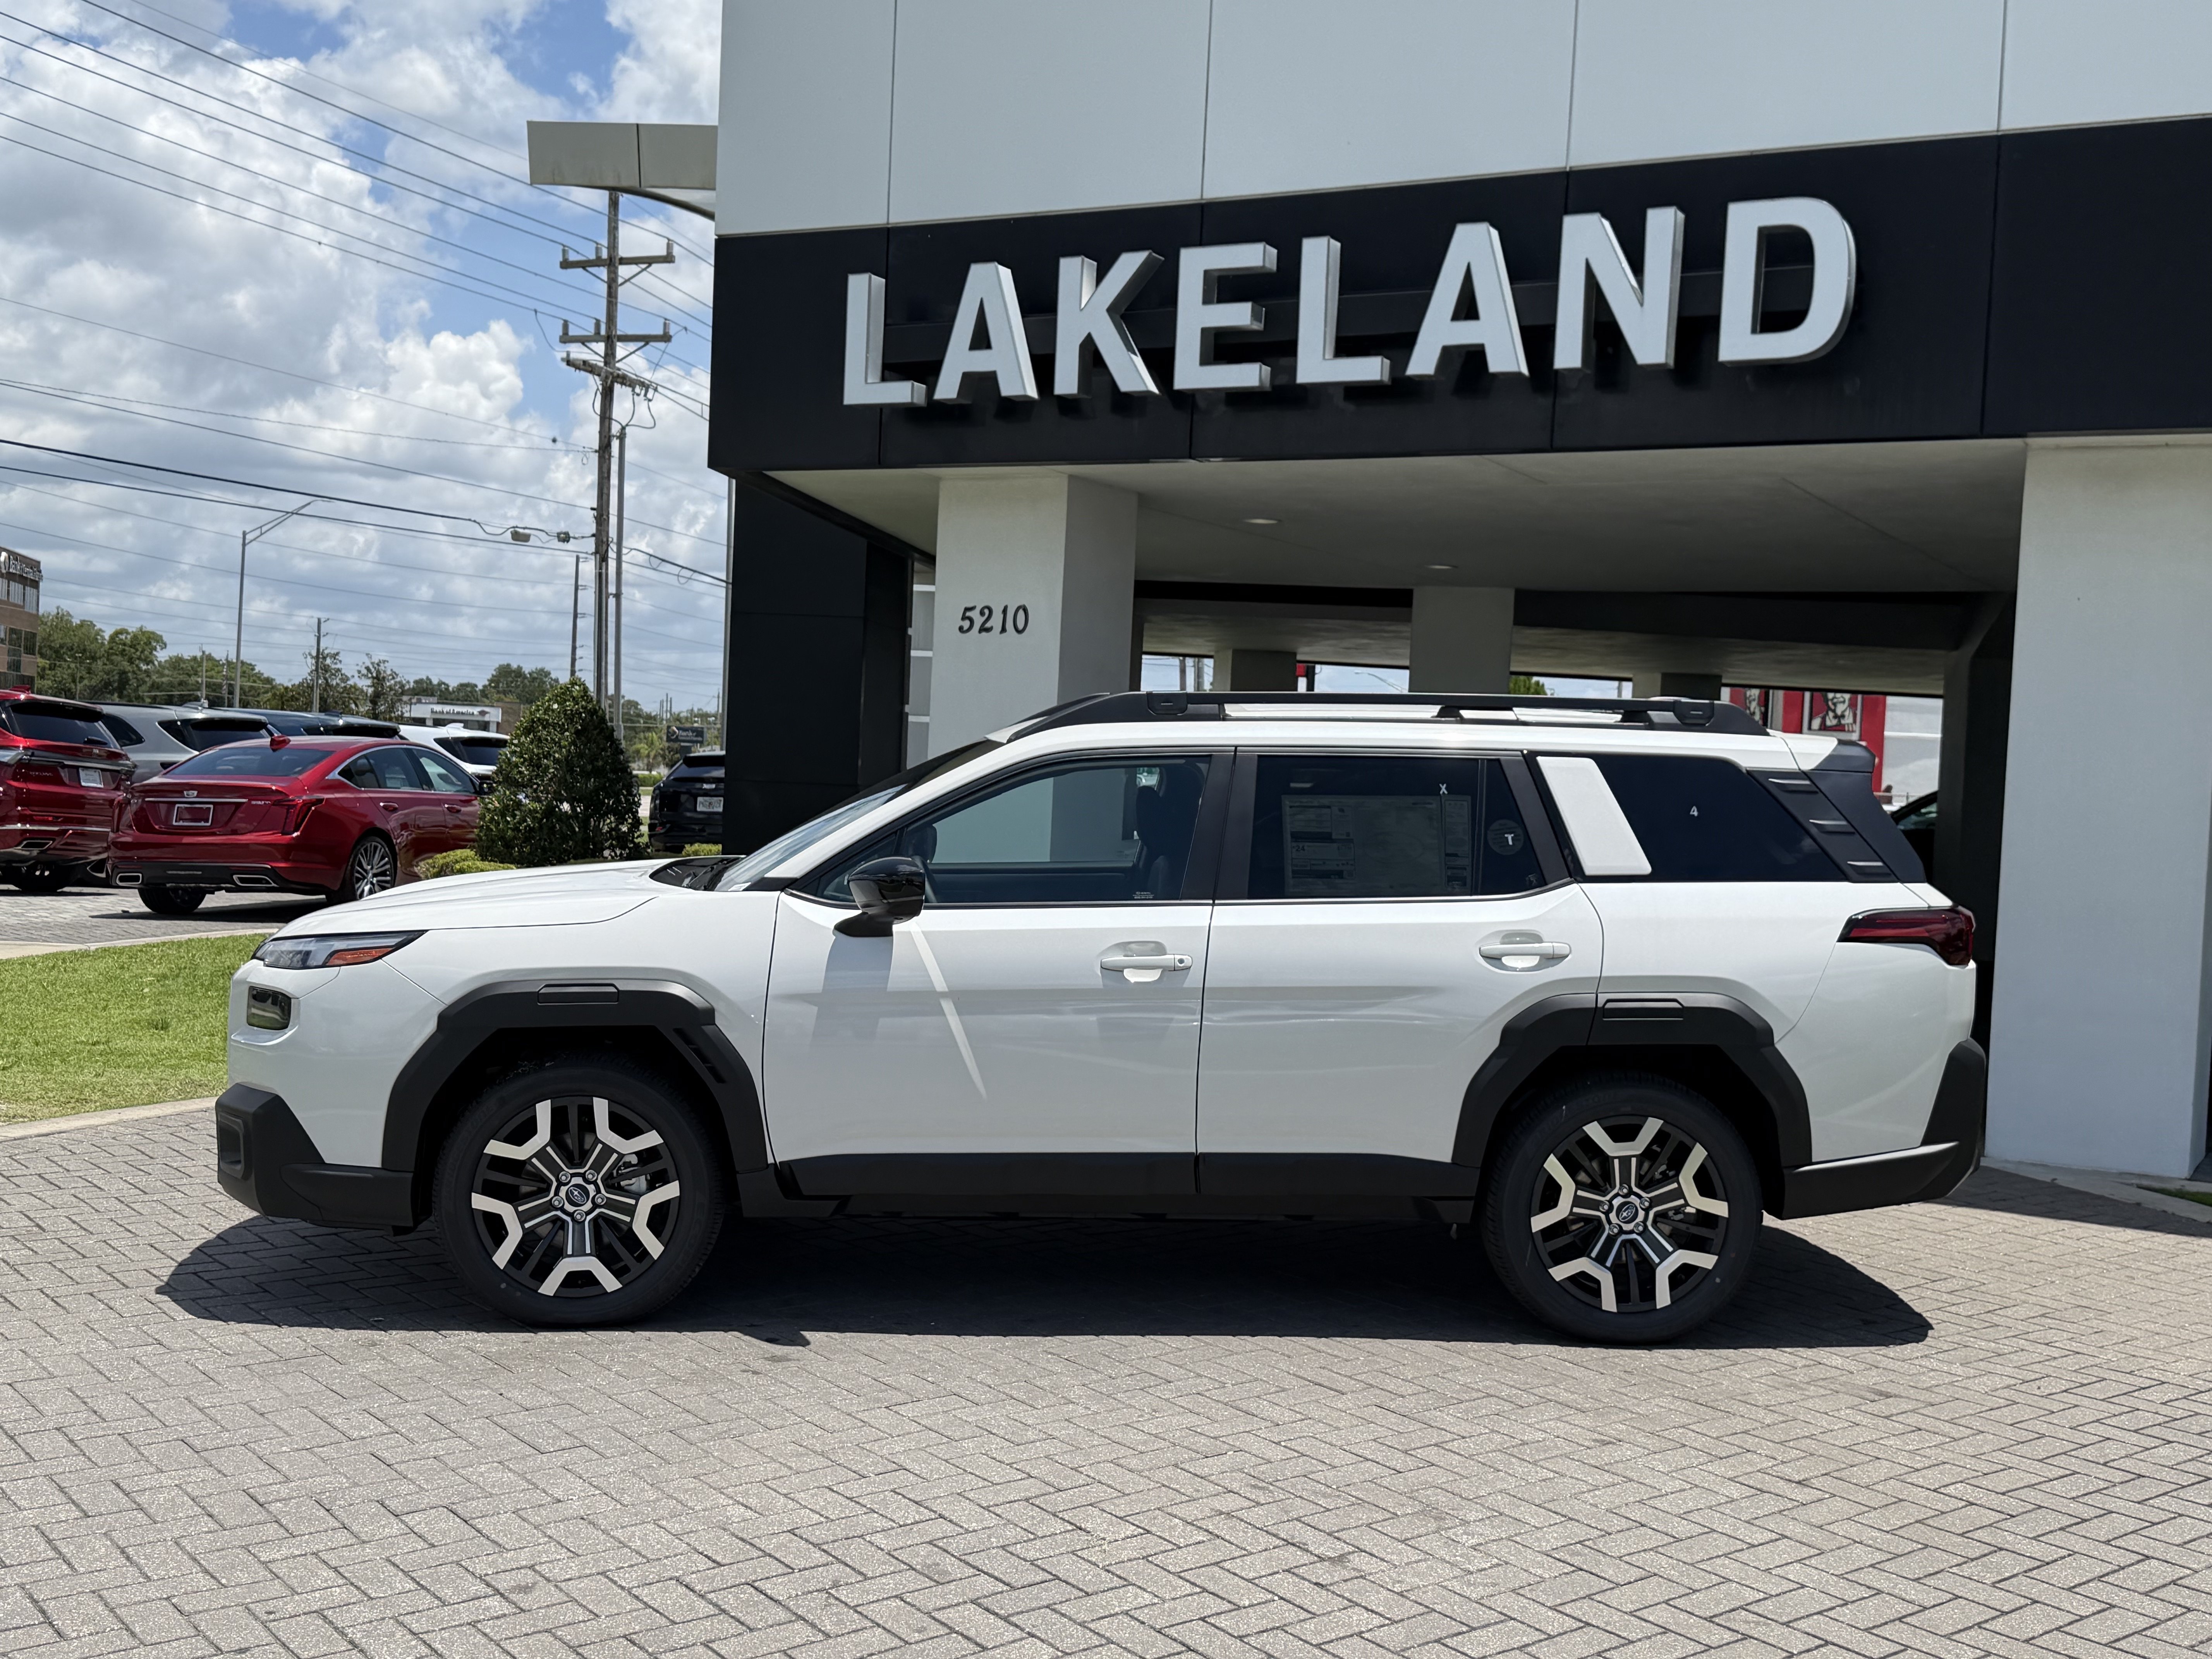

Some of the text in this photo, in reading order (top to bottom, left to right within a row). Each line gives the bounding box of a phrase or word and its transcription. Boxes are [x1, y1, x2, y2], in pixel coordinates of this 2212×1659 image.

[843, 196, 1857, 407] LAKELAND
[958, 604, 1029, 635] 5210
[1439, 783, 1448, 794] X
[1690, 805, 1698, 817] 4
[1504, 834, 1514, 845] T
